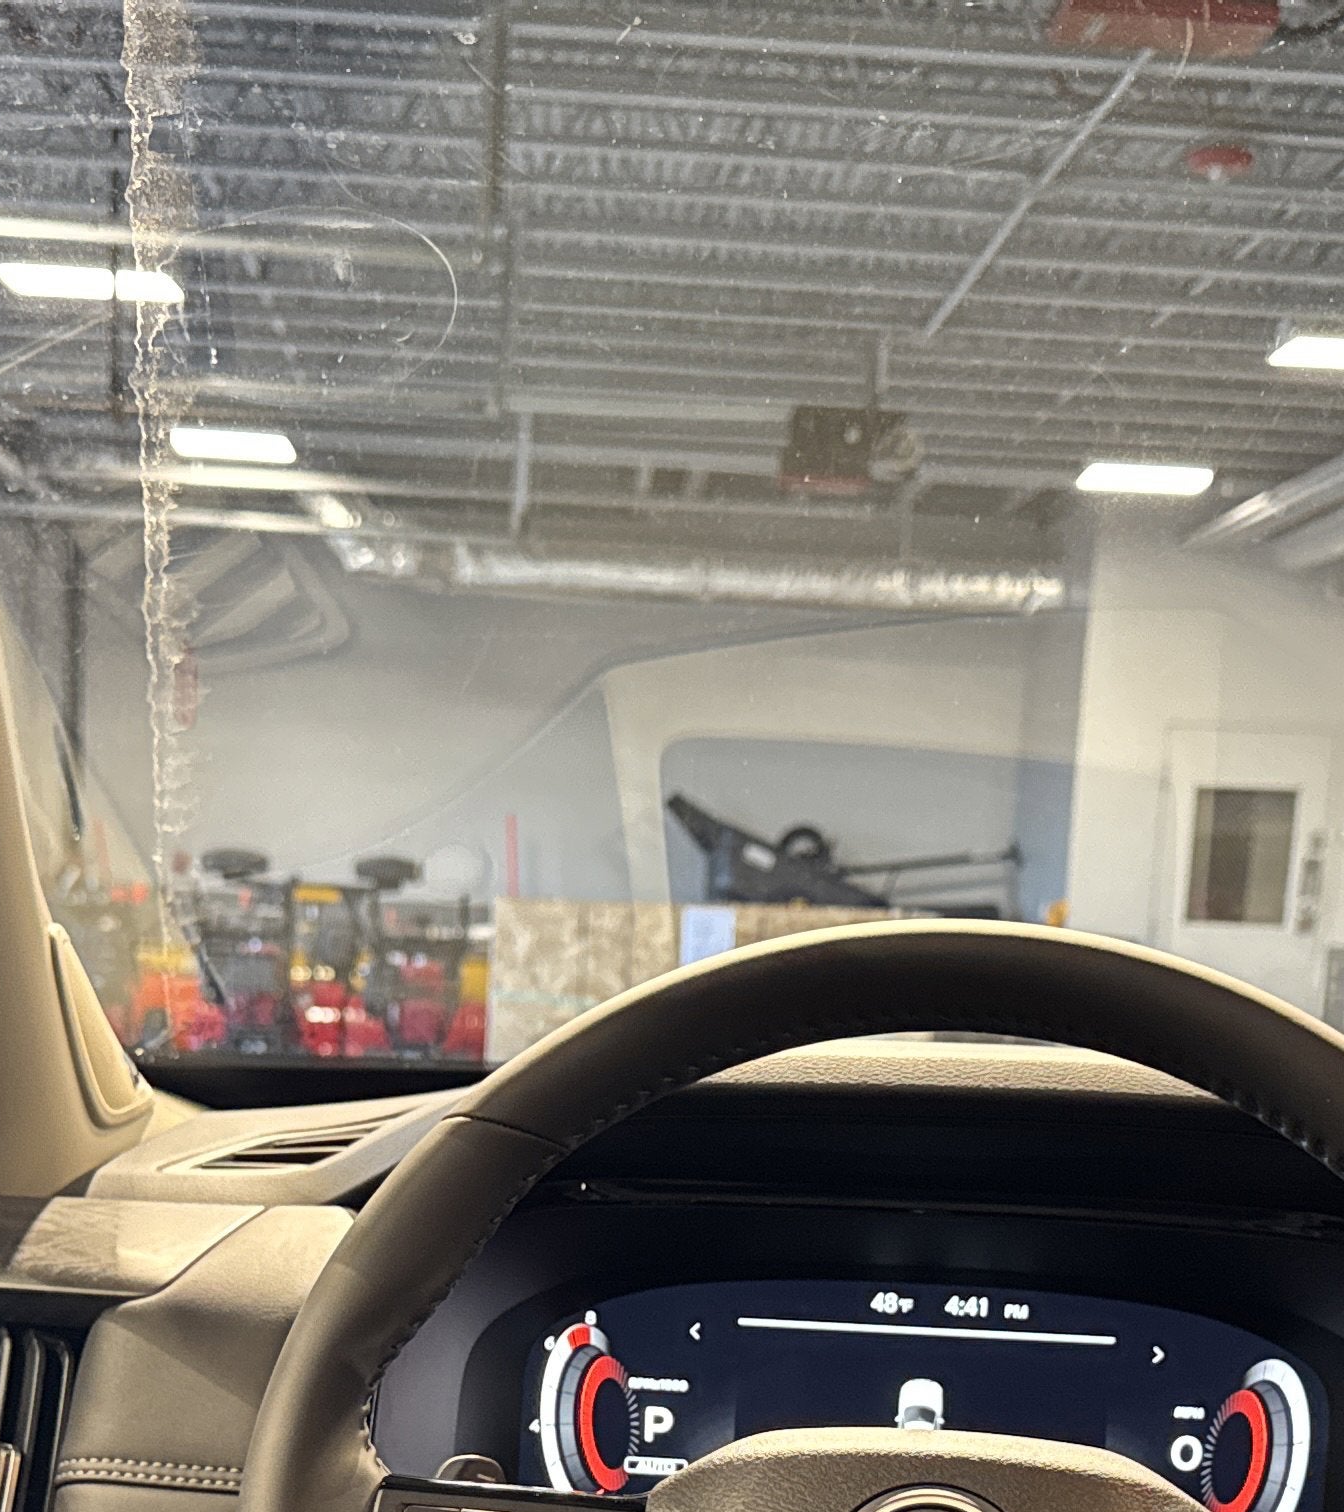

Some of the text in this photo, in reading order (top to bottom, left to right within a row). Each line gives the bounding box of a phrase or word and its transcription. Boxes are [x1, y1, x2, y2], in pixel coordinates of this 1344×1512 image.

[584, 1309, 598, 1325] 8
[944, 1294, 989, 1319] 4:41
[1003, 1303, 1030, 1321] PM
[643, 1405, 675, 1443] P
